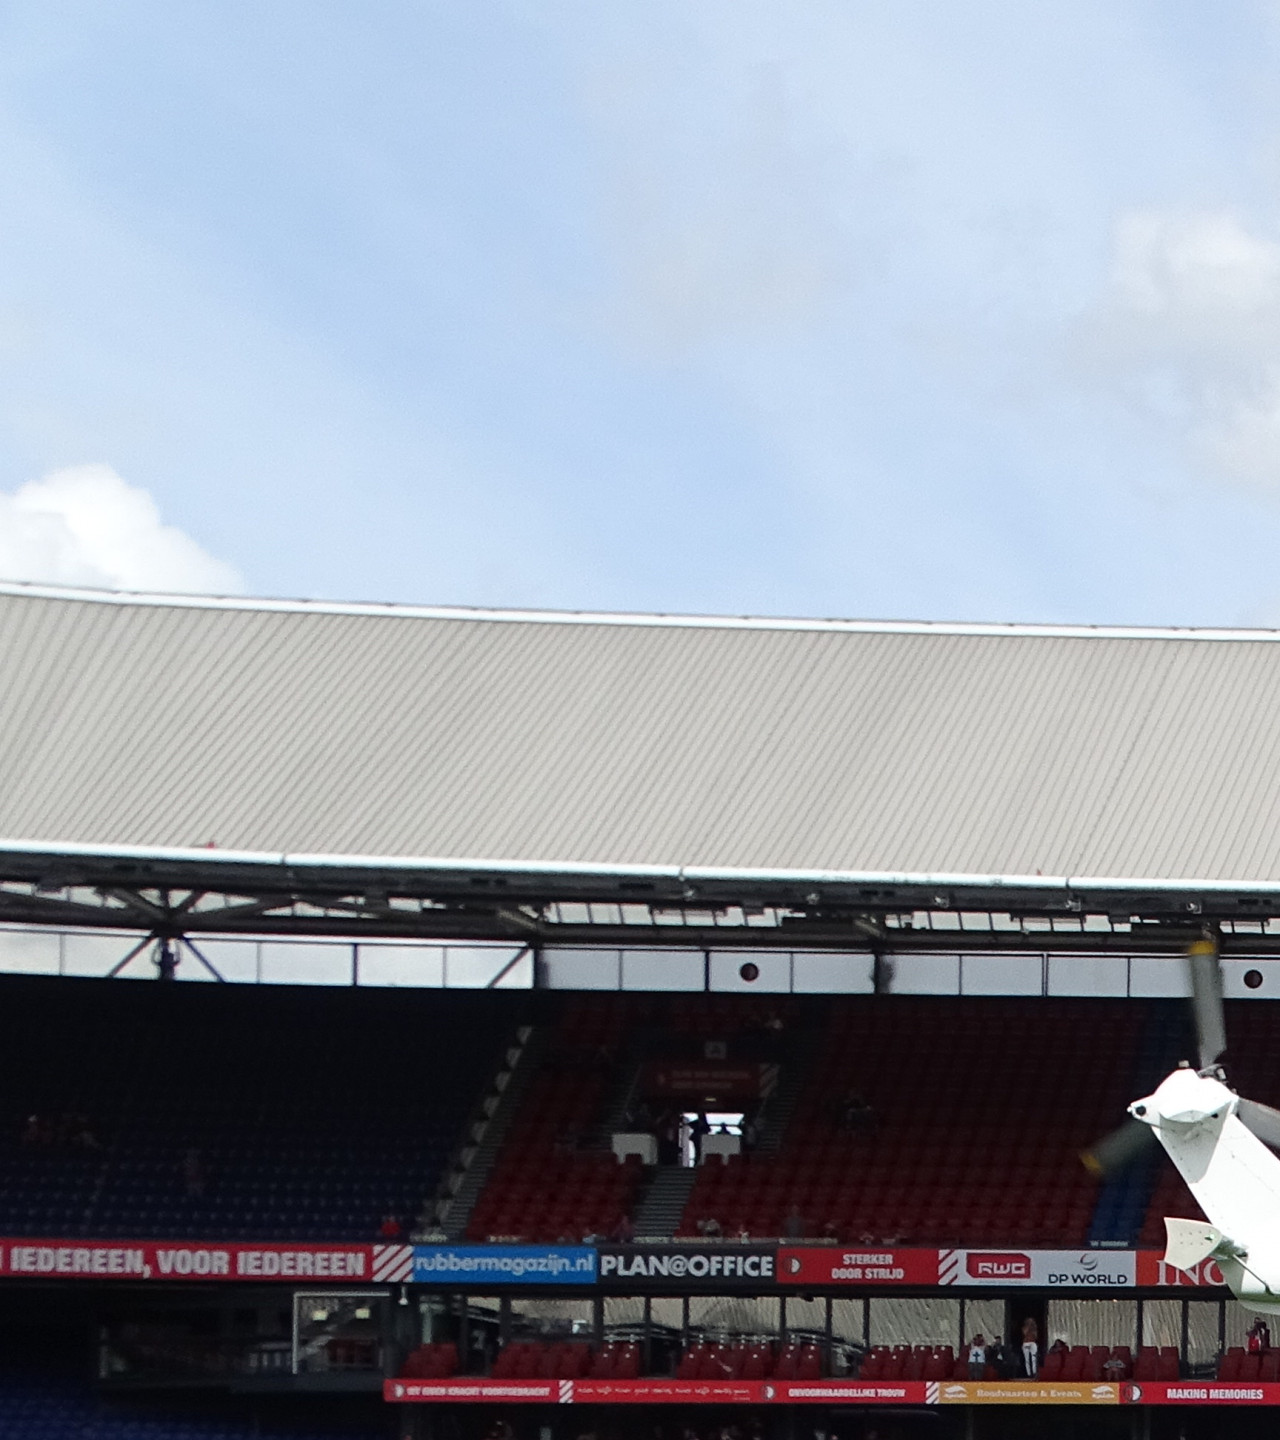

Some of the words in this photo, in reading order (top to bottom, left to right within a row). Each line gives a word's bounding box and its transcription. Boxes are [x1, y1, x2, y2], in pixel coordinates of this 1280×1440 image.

[10, 1246, 151, 1279] IEDEREEN,
[156, 1249, 230, 1275] VOOR
[237, 1251, 366, 1277] IEDEREEN
[416, 1252, 595, 1276] rubbermagazijn.nl
[600, 1254, 774, 1277] PLAN@OFFICE
[842, 1254, 893, 1266] STERKER
[831, 1267, 862, 1279] DOOR
[865, 1268, 904, 1279] STRIJD
[977, 1262, 1026, 1275] RWG
[1047, 1274, 1072, 1285] DP
[1074, 1274, 1128, 1285] WORLD
[1167, 1389, 1207, 1400] MAKING
[1209, 1389, 1264, 1400] MEMORIES
